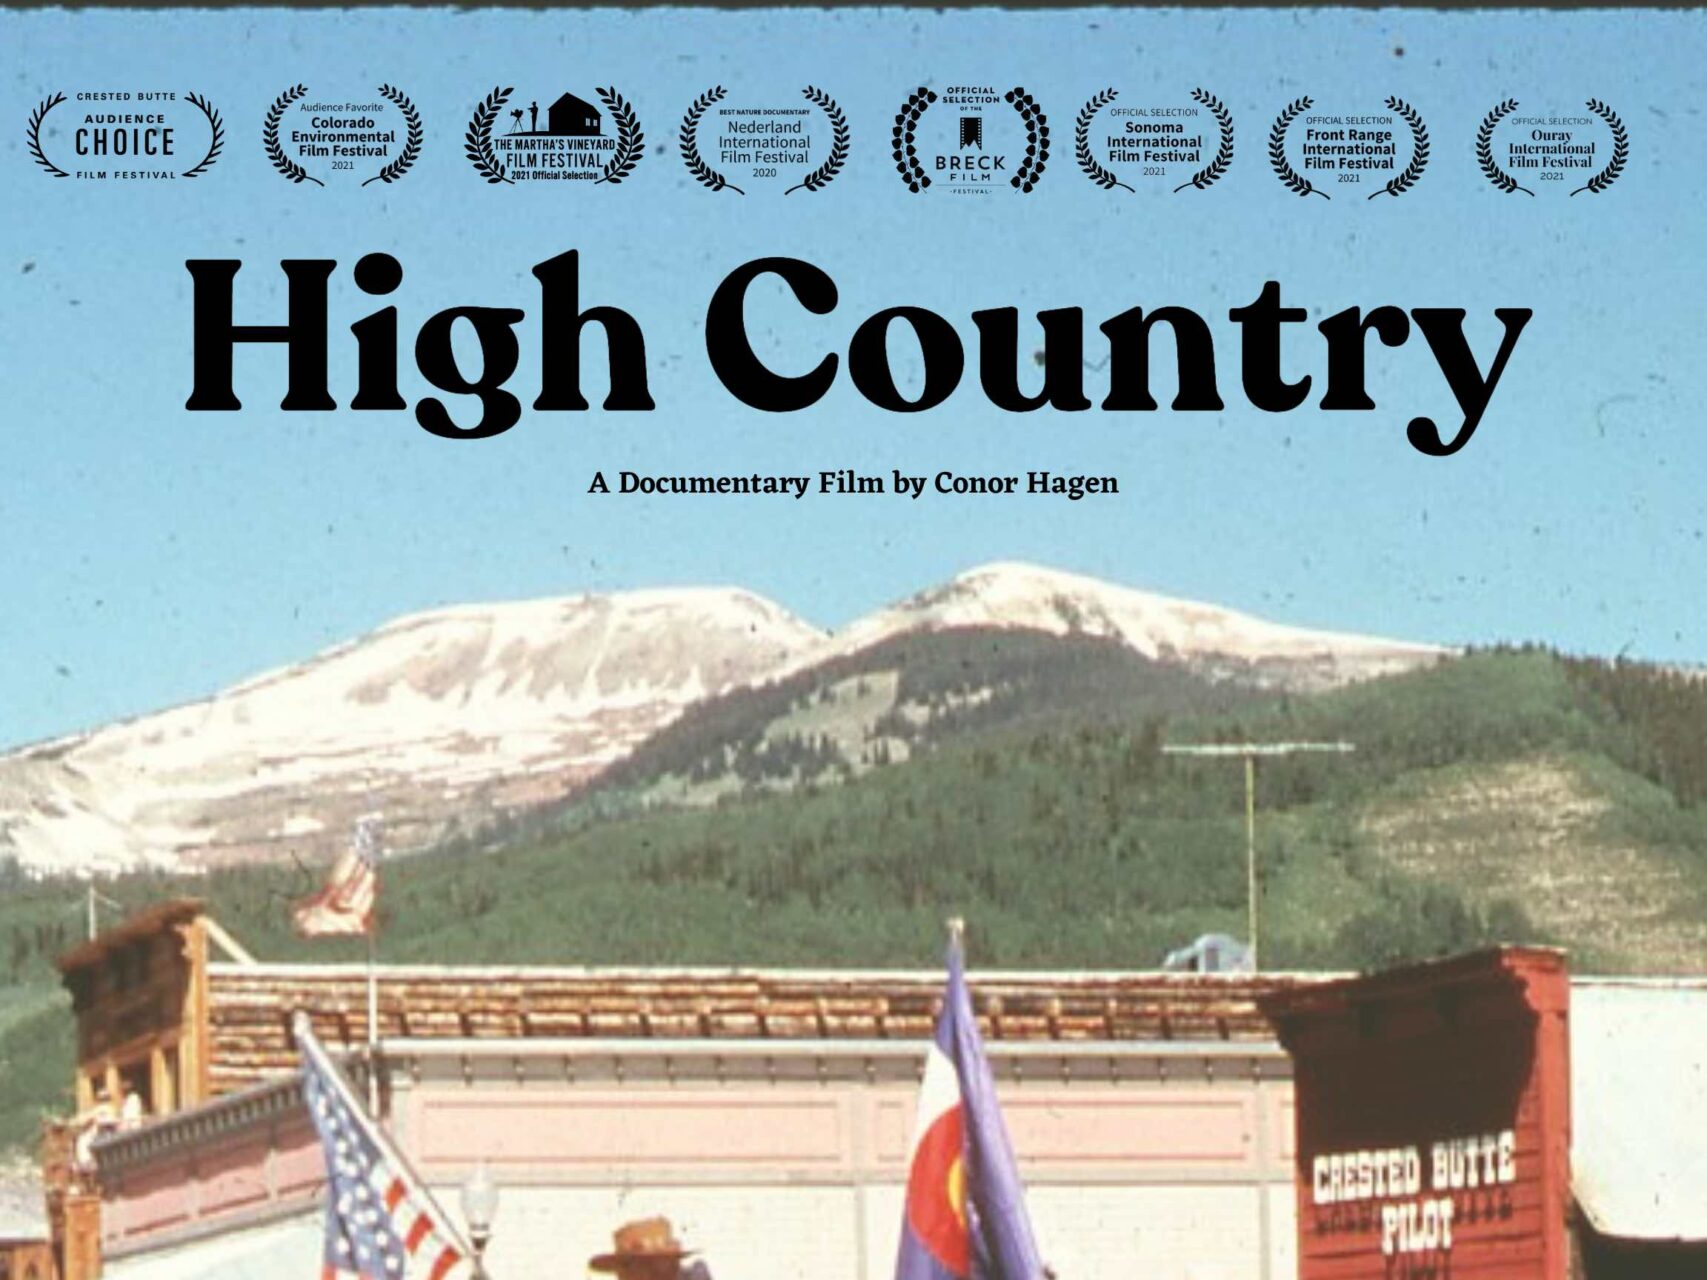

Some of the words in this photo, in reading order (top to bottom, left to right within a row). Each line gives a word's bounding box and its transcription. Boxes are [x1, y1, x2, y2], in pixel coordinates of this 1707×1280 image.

[1313, 1145, 1421, 1204] CRESTED
[1432, 1130, 1516, 1190] BUTTE
[1381, 1198, 1454, 1255] PILOT
